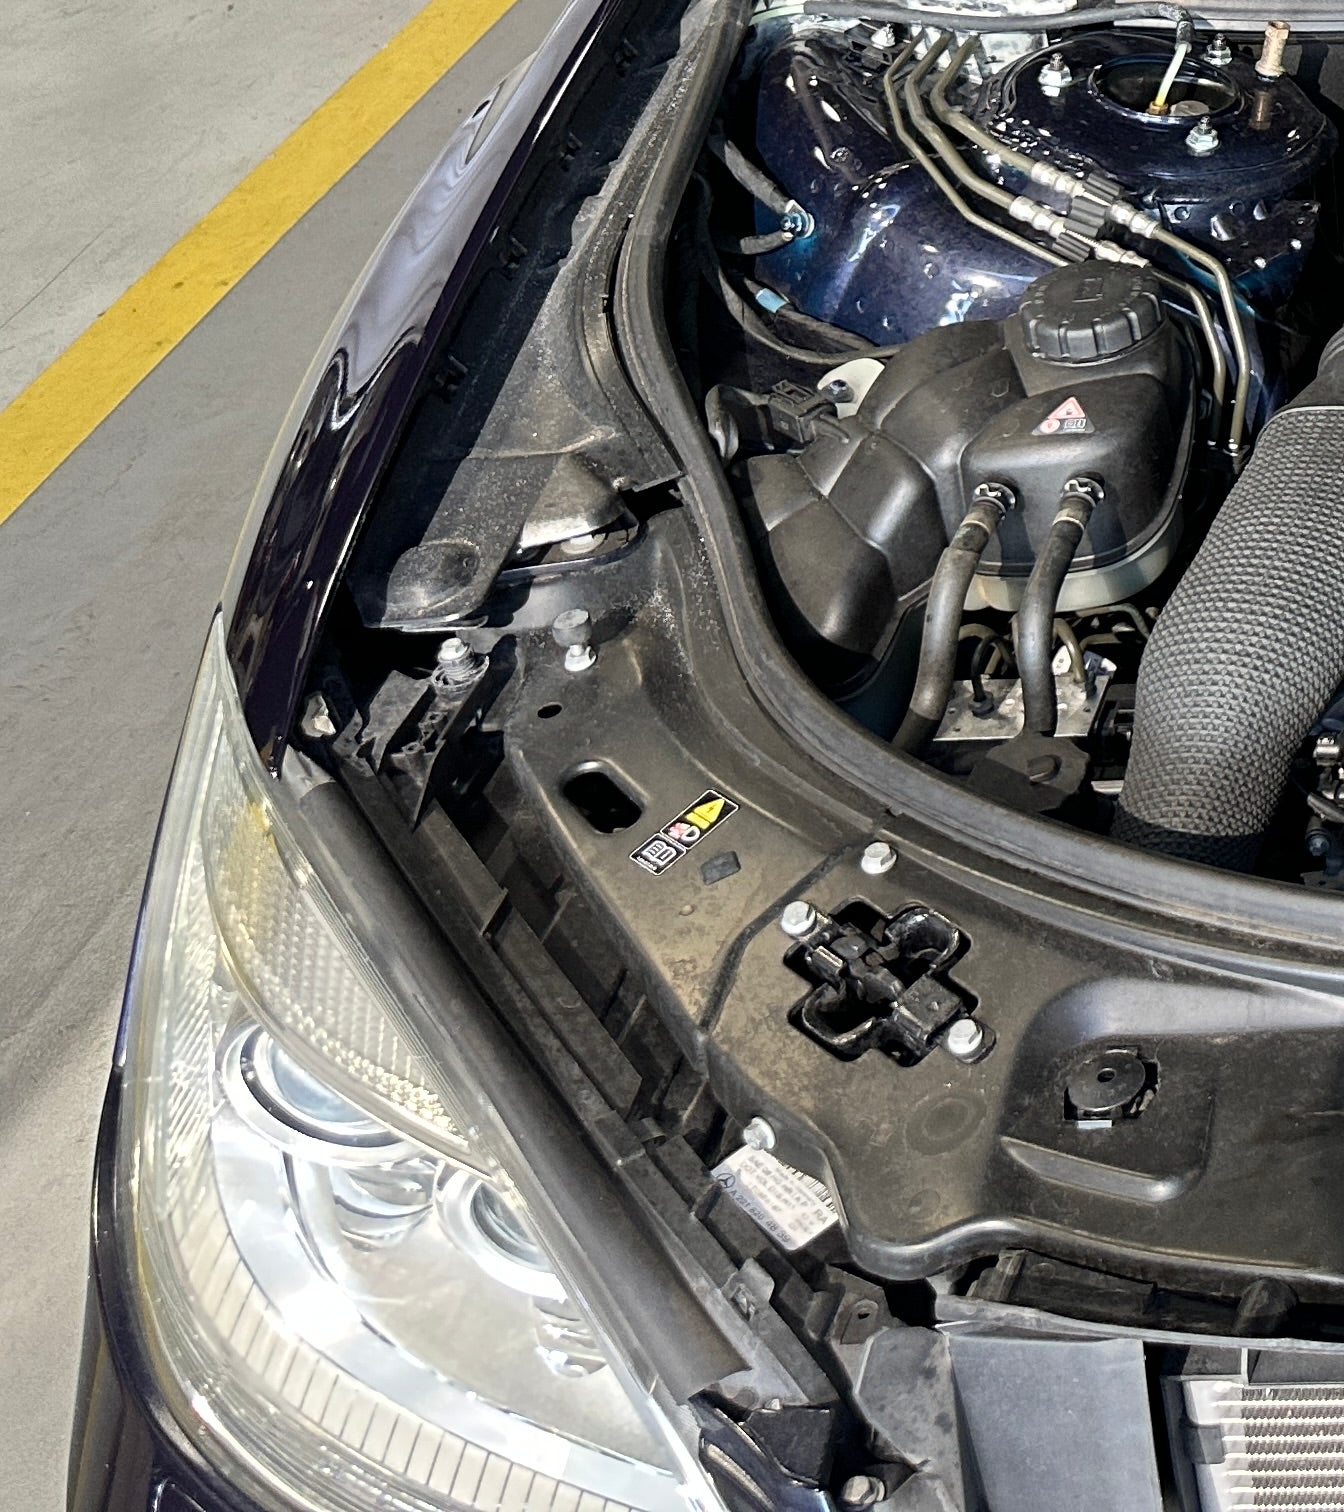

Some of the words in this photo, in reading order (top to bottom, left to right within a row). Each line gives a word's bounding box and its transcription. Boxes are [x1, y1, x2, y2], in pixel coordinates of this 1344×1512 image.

[729, 1189, 737, 1197] A
[734, 1193, 751, 1209] 221
[775, 1229, 792, 1244] 39
[812, 1207, 830, 1224] RA
